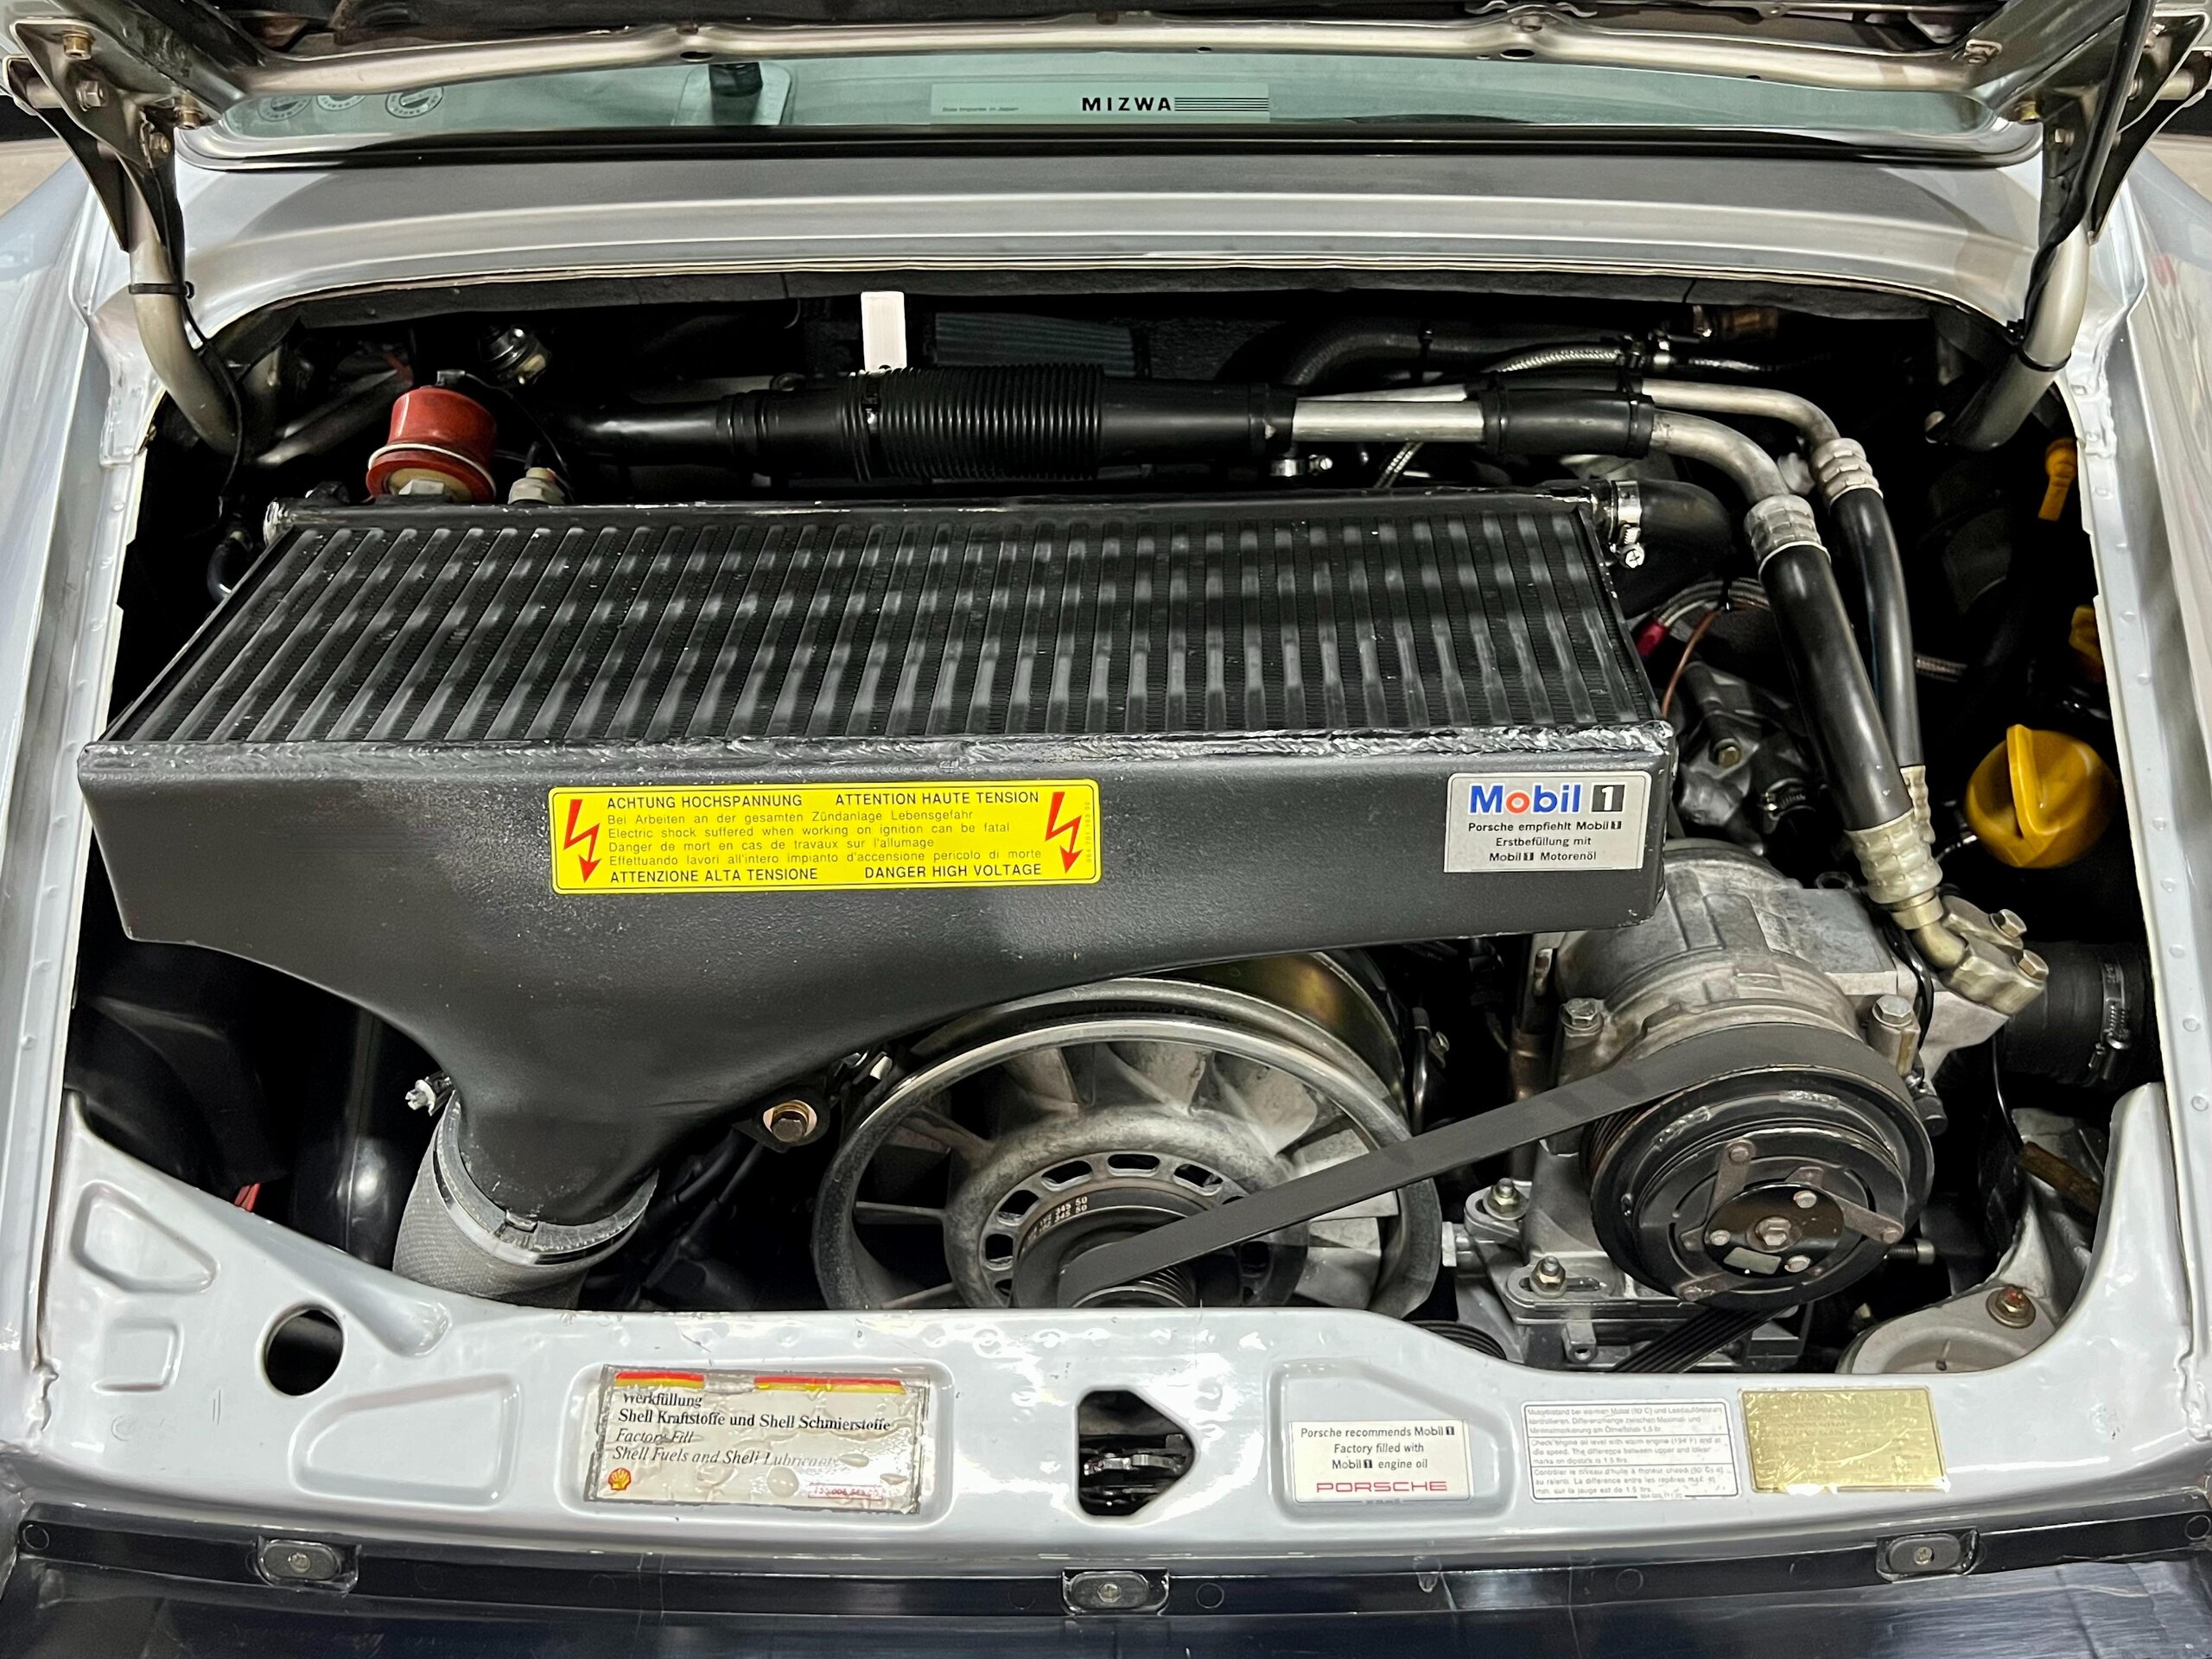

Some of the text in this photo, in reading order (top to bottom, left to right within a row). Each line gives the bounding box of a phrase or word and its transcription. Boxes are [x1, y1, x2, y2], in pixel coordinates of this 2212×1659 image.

[1082, 98, 1172, 111] MIZWA
[607, 794, 803, 809] ACHTUNG HOCHSPANNUNG
[836, 791, 1039, 805] ATTENTION HAUTE TENSION
[1470, 784, 1580, 814] Mobil
[608, 815, 626, 824] Bei
[636, 814, 685, 824] Arbeiten
[716, 814, 736, 823] der
[744, 813, 804, 826] gesamten
[812, 810, 882, 823] Zündanlage
[891, 809, 973, 822] Lebensgefahr
[608, 822, 1010, 838] Electric shock suffered when working on ignition can be fatal
[1469, 822, 1513, 832] Porsche
[1518, 822, 1571, 833] empfiehlt
[1576, 821, 1609, 830] Mobil
[608, 842, 652, 855] Danger
[660, 842, 676, 851] de
[683, 842, 710, 851] mort
[741, 842, 762, 850] cas
[770, 840, 785, 849] de
[794, 839, 838, 850] travaux
[847, 840, 865, 849] sur
[874, 837, 934, 850] l'allumage
[1496, 836, 1592, 847] Erstbefüllung mit
[609, 849, 1042, 866] Effettuando lavori all'intero impianto d'accensione pericolo di morte
[1489, 852, 1521, 861] Mobil
[1540, 851, 1597, 861] Motorenöl
[610, 868, 818, 883] ATTENZIONE ALTA TENSIONE
[865, 862, 1042, 879] DANGER HIGH VOLTAGE
[624, 1393, 702, 1408] Werkfüllung
[618, 1408, 891, 1431] Shell Kraftstoffe und Shell Schmierstoffe
[671, 1430, 694, 1444] Fill
[1300, 1427, 1342, 1438] Porsche
[1345, 1427, 1412, 1438] recommends
[1414, 1427, 1444, 1436] Mobil
[613, 1446, 649, 1460] Shell
[652, 1446, 689, 1462] Fuels
[691, 1451, 720, 1463] and
[1334, 1442, 1424, 1455] Factory filled with
[1332, 1459, 1362, 1469] Mobil
[1378, 1460, 1412, 1471] engine
[1415, 1459, 1428, 1468] oil
[1316, 1481, 1448, 1493] PORSCHE
